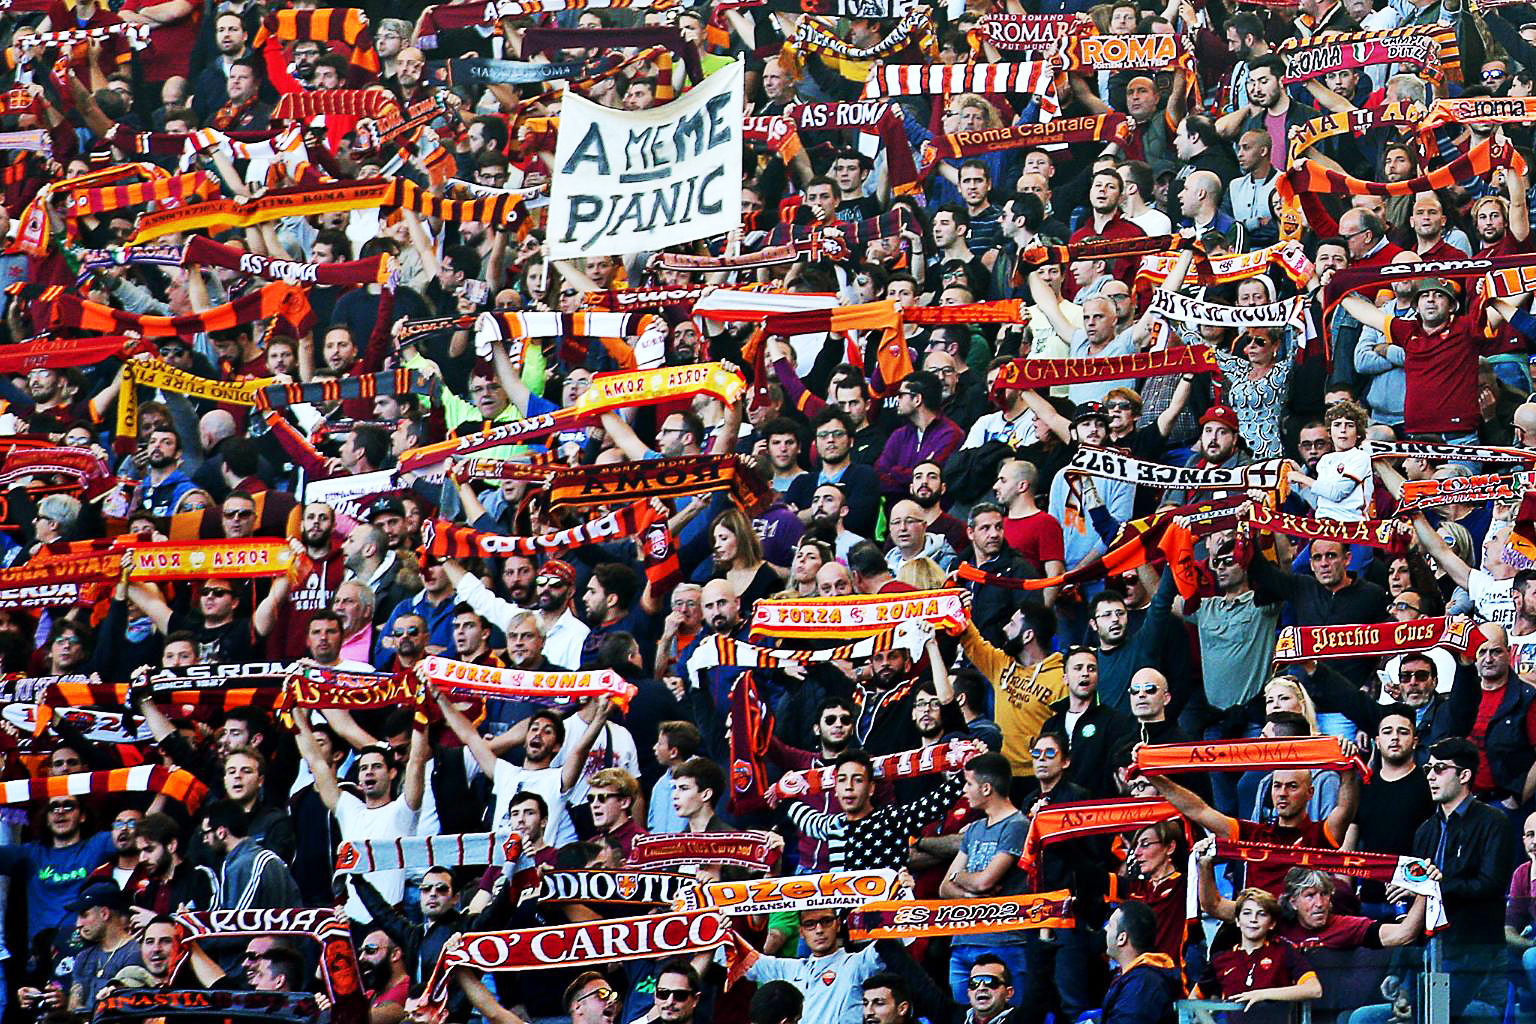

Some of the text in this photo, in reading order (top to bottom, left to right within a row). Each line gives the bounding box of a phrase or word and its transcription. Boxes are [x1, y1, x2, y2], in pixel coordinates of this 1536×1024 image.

[1082, 36, 1176, 65] ROMA
[1289, 45, 1342, 78] ROMA
[1474, 99, 1526, 117] roma
[959, 118, 1096, 147] Roma Capitale
[561, 121, 611, 176] A
[303, 187, 385, 204] ROMA 1927
[1024, 348, 1192, 380] GARBATELLA
[1136, 461, 1232, 485] SINCE
[777, 599, 940, 625] FORZA ROMA
[1312, 622, 1434, 654] Vecchio Cucs
[444, 663, 591, 689] FORZA ROMA
[540, 871, 615, 902] ODIO
[733, 895, 868, 914] BOSANSKI DIJAMANT
[933, 901, 1020, 923] roma
[210, 907, 315, 933] ROMA
[531, 909, 725, 964] CARICO
